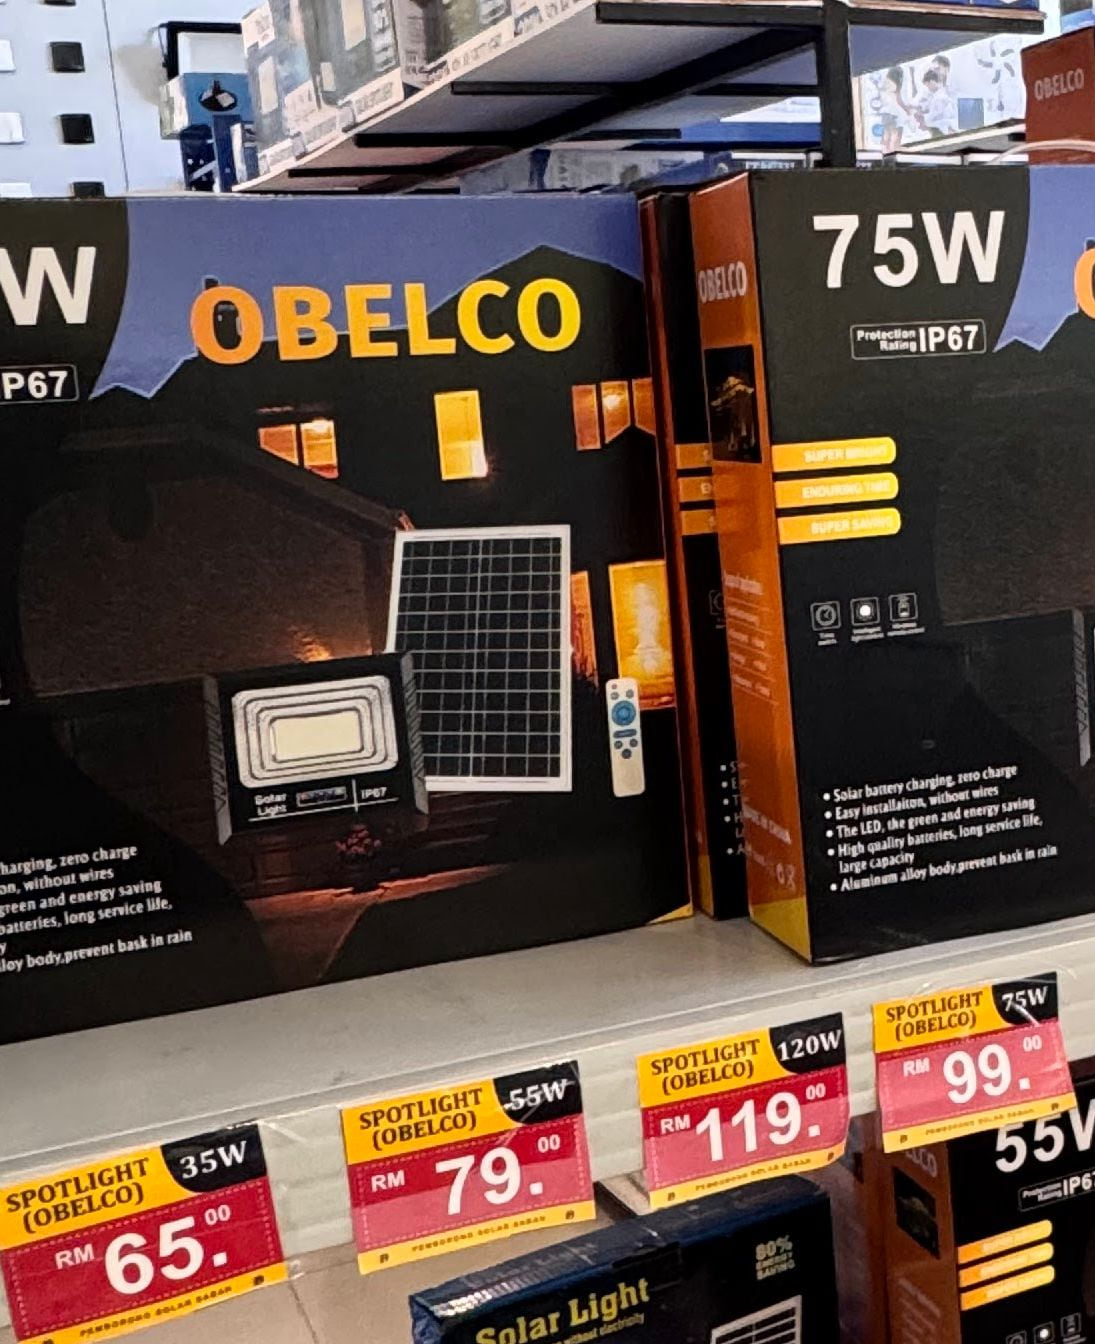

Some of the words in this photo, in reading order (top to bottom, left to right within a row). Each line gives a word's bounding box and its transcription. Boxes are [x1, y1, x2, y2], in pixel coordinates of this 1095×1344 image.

[1034, 67, 1085, 102] OBELCO
[812, 210, 1006, 289] 75W
[698, 261, 748, 304] OBELCO
[190, 277, 582, 364] OBELCO
[856, 327, 917, 343] Protection
[919, 324, 979, 353] IP67
[880, 339, 917, 354] Rating
[0, 371, 69, 400] P67
[833, 788, 863, 803] Solar
[865, 782, 904, 799] battery
[957, 771, 981, 784] zero
[982, 764, 1019, 780] charge
[834, 806, 860, 821] Easy
[928, 790, 970, 806] without
[972, 785, 999, 799] wires
[836, 823, 859, 839] The
[887, 816, 906, 831] the
[907, 811, 939, 830] green
[940, 807, 961, 823] and
[962, 801, 1000, 819] energy
[1001, 797, 1036, 813] saving
[836, 841, 866, 859] High
[866, 834, 906, 854] quality
[959, 822, 983, 838] long
[984, 817, 1021, 834] service
[838, 858, 867, 875] large
[868, 851, 915, 870] capacity
[839, 871, 898, 893] Aluminum
[899, 864, 928, 882] alloy
[999, 848, 1023, 865] bask
[1037, 844, 1058, 858] rain
[886, 990, 984, 1024] SPOTLIGHT
[1001, 985, 1049, 1013] 75W
[895, 1009, 977, 1043] (OBELCO)
[650, 1038, 761, 1076] SPOTLIGHT
[776, 1028, 843, 1062] 120W
[902, 1057, 931, 1078] RM
[1022, 1034, 1042, 1052] 00
[662, 1059, 755, 1096] (OBELCO)
[359, 1088, 483, 1130] SPOTLIGHT
[509, 1078, 571, 1111] 55W
[660, 1113, 691, 1135] RM
[805, 1082, 826, 1101] 00
[372, 1110, 477, 1152] (OBELCO)
[6, 1157, 150, 1213] SPOTLIGHT
[179, 1140, 248, 1180] 35W
[371, 1170, 405, 1193] RM
[537, 1133, 561, 1154] 00
[23, 1181, 144, 1234] (OBELCO)
[54, 1243, 95, 1270] RM
[203, 1203, 232, 1227] 00
[567, 1276, 651, 1328] Light
